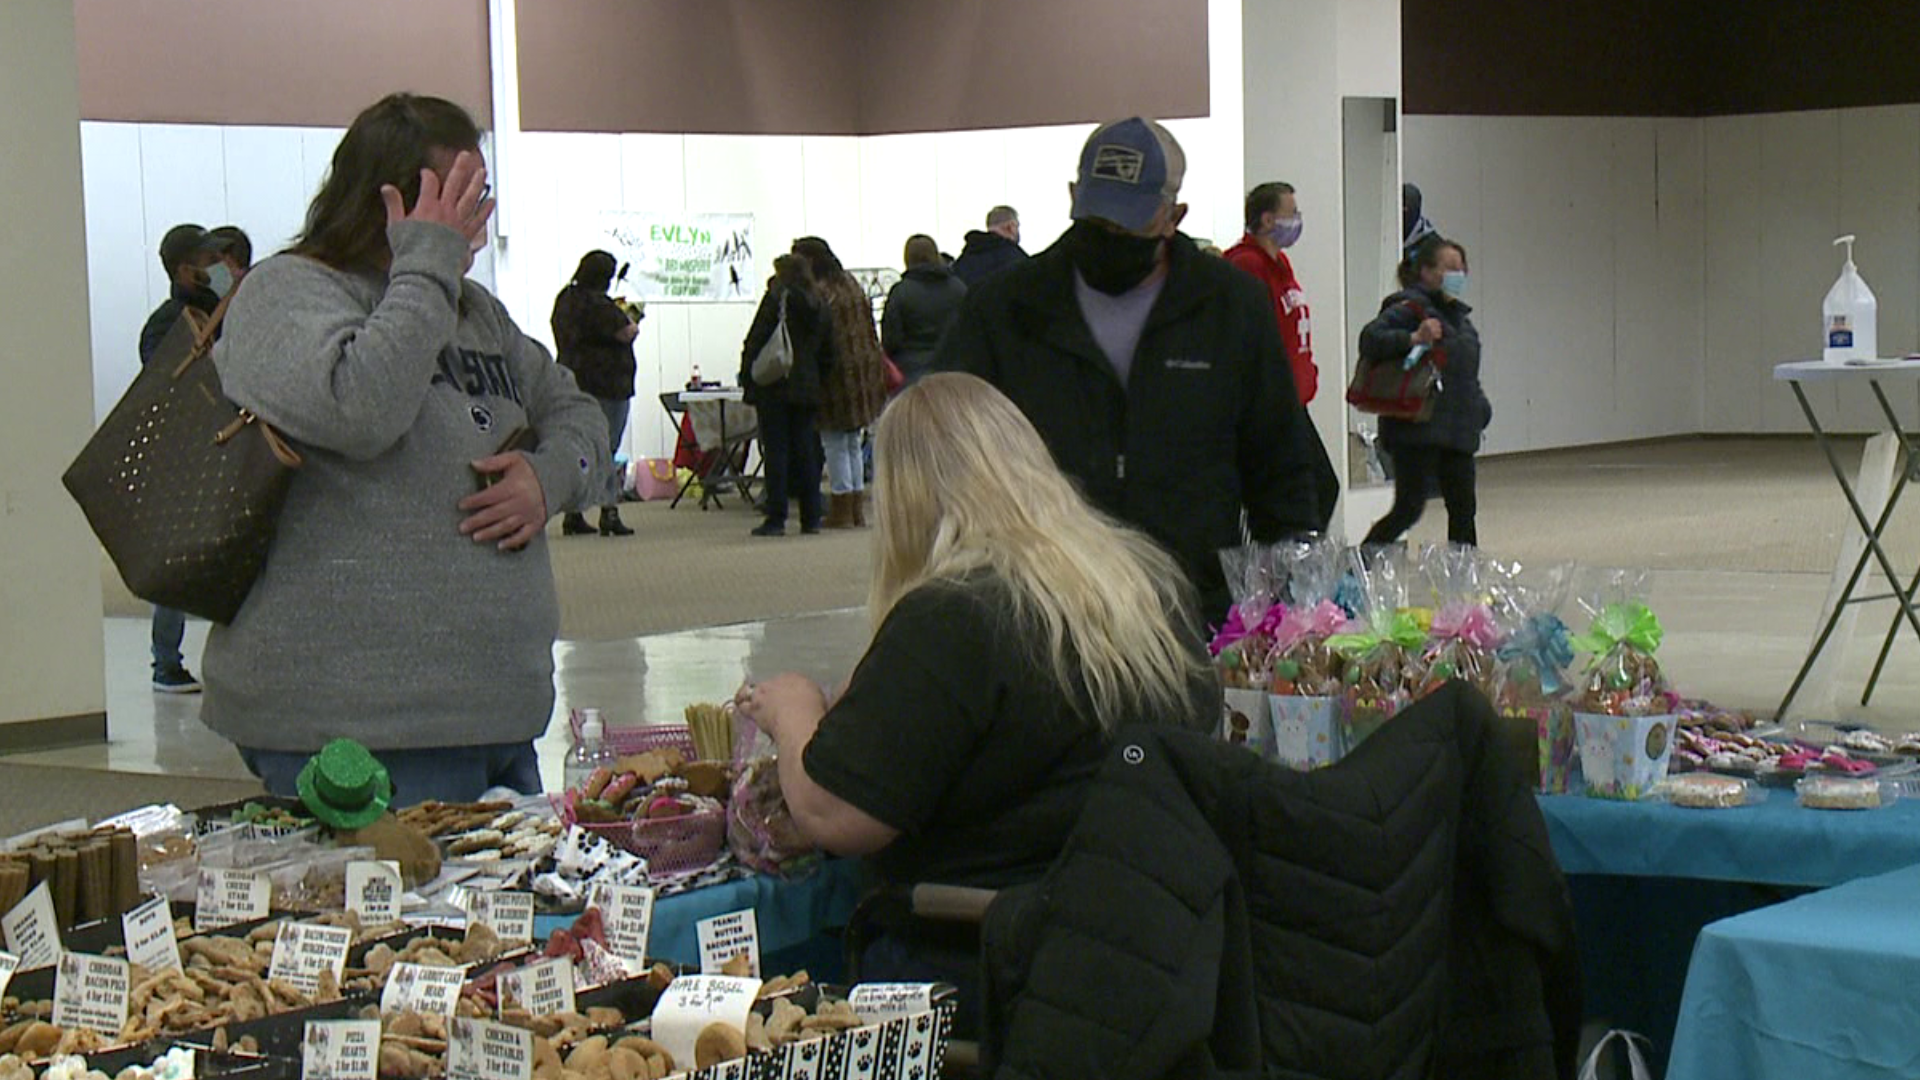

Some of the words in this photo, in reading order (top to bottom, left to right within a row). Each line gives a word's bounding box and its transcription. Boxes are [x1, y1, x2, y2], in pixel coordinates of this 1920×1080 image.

[226, 882, 250, 891] CHEESE
[226, 901, 235, 909] for
[620, 920, 628, 931] for
[712, 914, 742, 927] PEANUT
[501, 922, 509, 934] for
[714, 926, 743, 938] BUTTER
[706, 939, 731, 951] BACON
[309, 956, 317, 968] for
[717, 952, 728, 960] for
[89, 962, 122, 976] CHEDDAR
[537, 966, 554, 977] VERY
[85, 975, 108, 988] BACON
[110, 978, 126, 991] PIGS
[535, 977, 556, 991] BERRY
[670, 978, 701, 992] APPLE
[709, 979, 744, 993] BAGEL
[92, 989, 101, 1001] for
[103, 991, 122, 1005] $1.00
[420, 999, 429, 1011] for
[537, 1005, 546, 1014] for
[485, 1028, 514, 1043] CHICKEN
[340, 1045, 367, 1058] HEARTS
[482, 1042, 524, 1061] VEGETABLES
[341, 1060, 350, 1072] for
[350, 1060, 369, 1073] $1.00
[491, 1059, 501, 1072] for
[502, 1060, 520, 1076] $1.00
